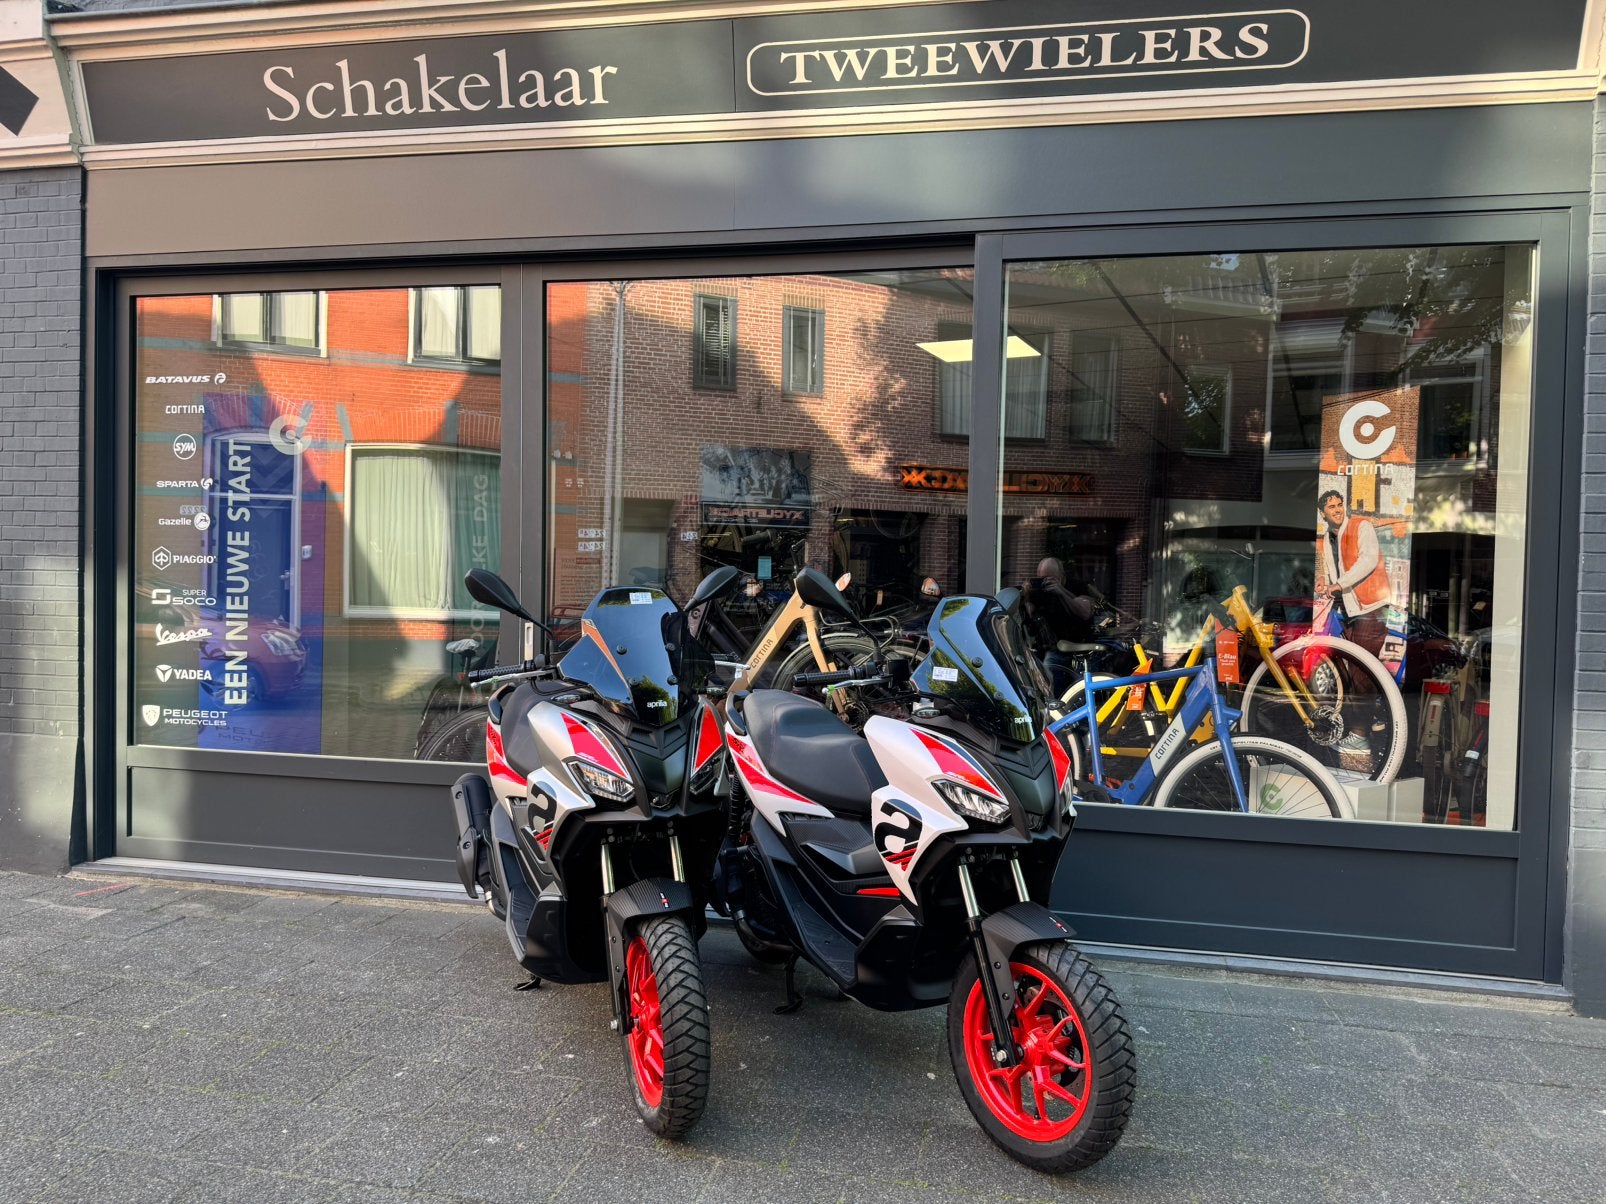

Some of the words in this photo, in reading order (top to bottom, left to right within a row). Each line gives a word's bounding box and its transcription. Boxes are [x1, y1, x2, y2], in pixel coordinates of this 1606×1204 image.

[780, 23, 1269, 85] TWEEWIELERS
[263, 48, 618, 122] Schakelaar
[145, 375, 211, 384] BATAVUS
[156, 480, 199, 489] SPARTA
[226, 438, 252, 522] START
[158, 517, 192, 526] Gazelle
[173, 554, 215, 564] PIAGGIO
[225, 531, 250, 641] NIEUWE
[172, 597, 217, 606] SOCO
[155, 622, 213, 646] Vespa
[174, 669, 212, 681] YADEA
[224, 650, 249, 705] EEN
[163, 708, 228, 719] PEUGEOT
[164, 718, 227, 727] MOTOCYCLES
